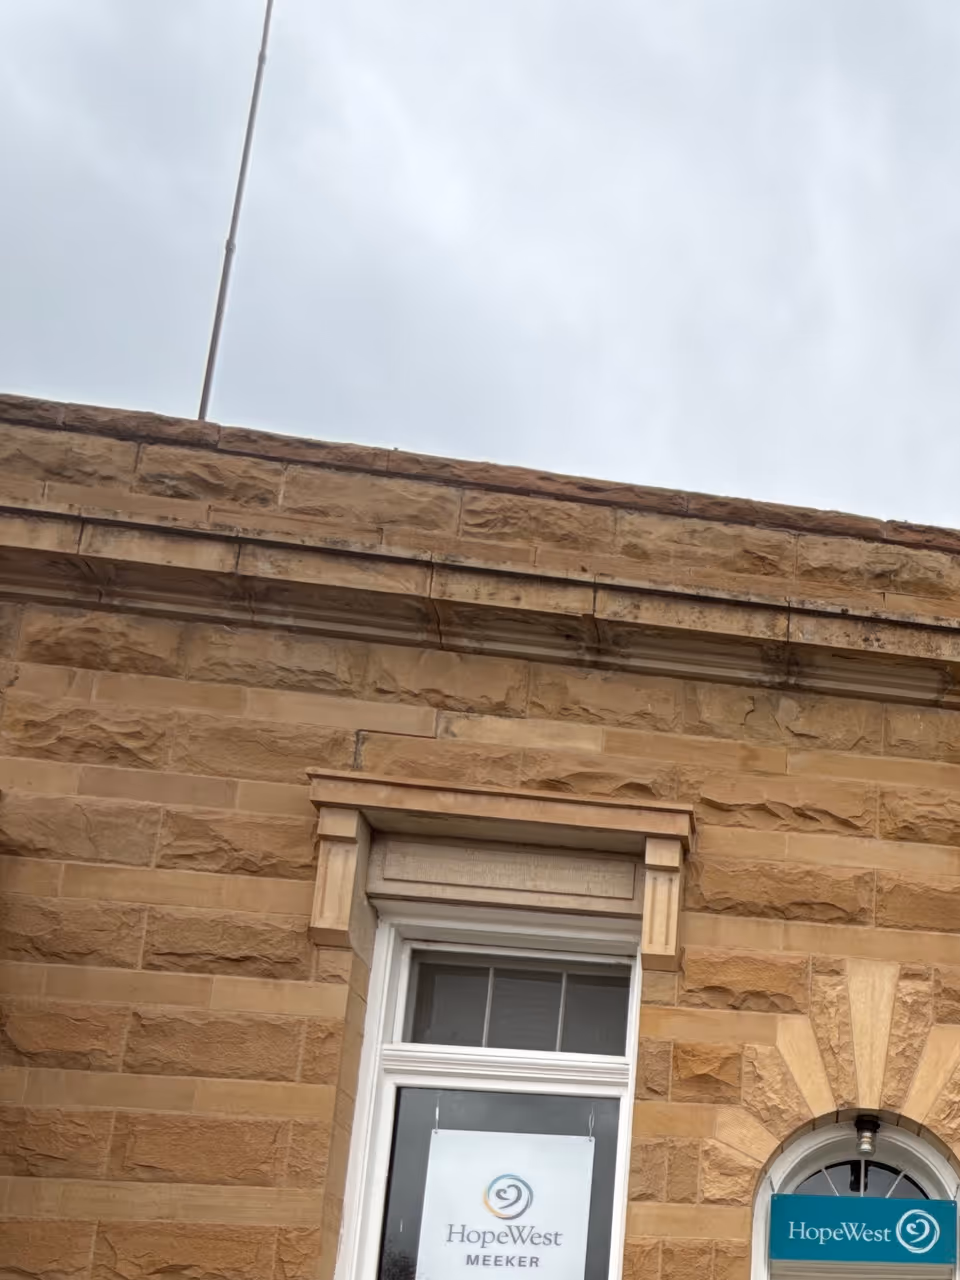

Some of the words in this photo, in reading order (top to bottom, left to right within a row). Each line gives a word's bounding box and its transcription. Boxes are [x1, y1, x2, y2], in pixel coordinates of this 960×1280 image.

[446, 1223, 564, 1249] HopeWest
[788, 1220, 892, 1246] HopeWest
[466, 1254, 540, 1268] MEEKER
